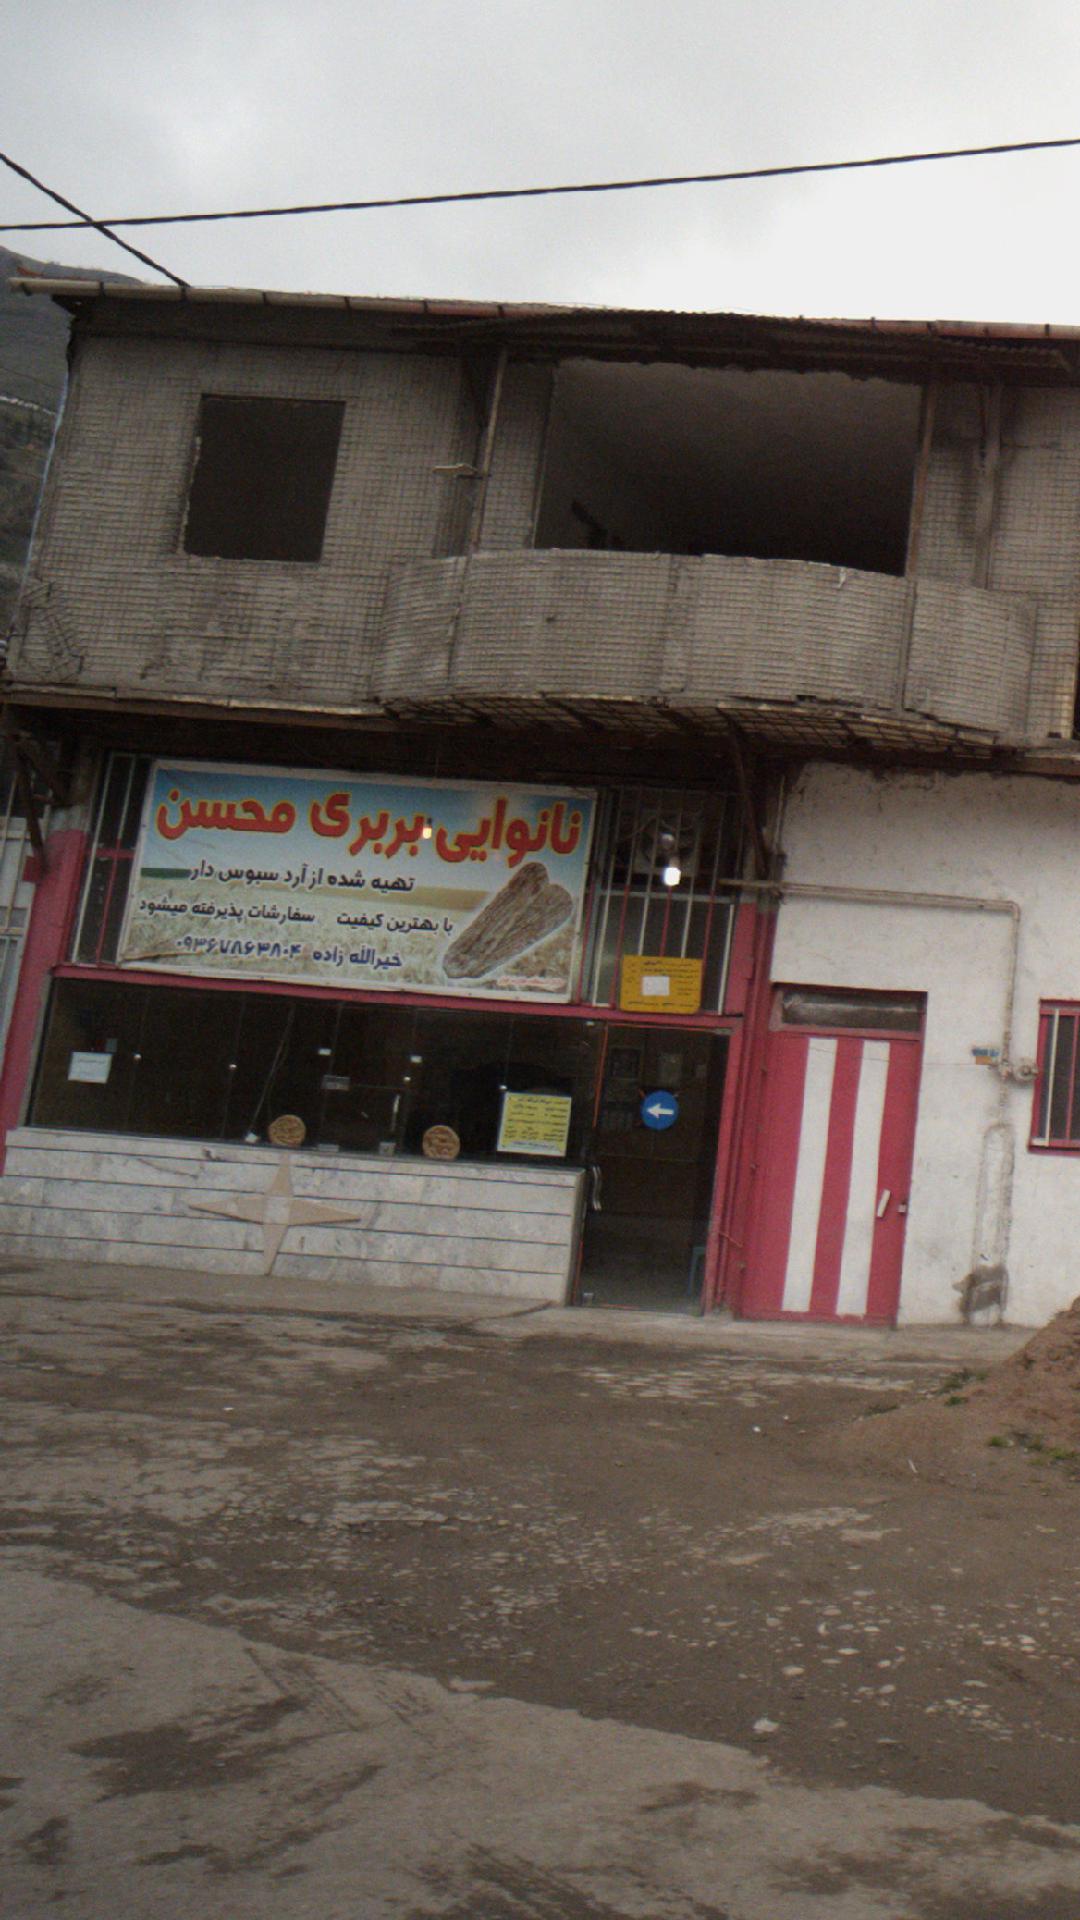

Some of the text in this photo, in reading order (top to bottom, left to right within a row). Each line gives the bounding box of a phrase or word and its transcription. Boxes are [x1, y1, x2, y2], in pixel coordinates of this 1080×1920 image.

[157, 789, 582, 869] نانوایی بربری محسن
[189, 859, 415, 894] تهیه شده از آرد سبوس دار
[139, 898, 454, 936] با بهترین کیفیت سفارشات پذیرفته میشود
[312, 945, 344, 967] زاده
[349, 944, 402, 970] خیرالله
